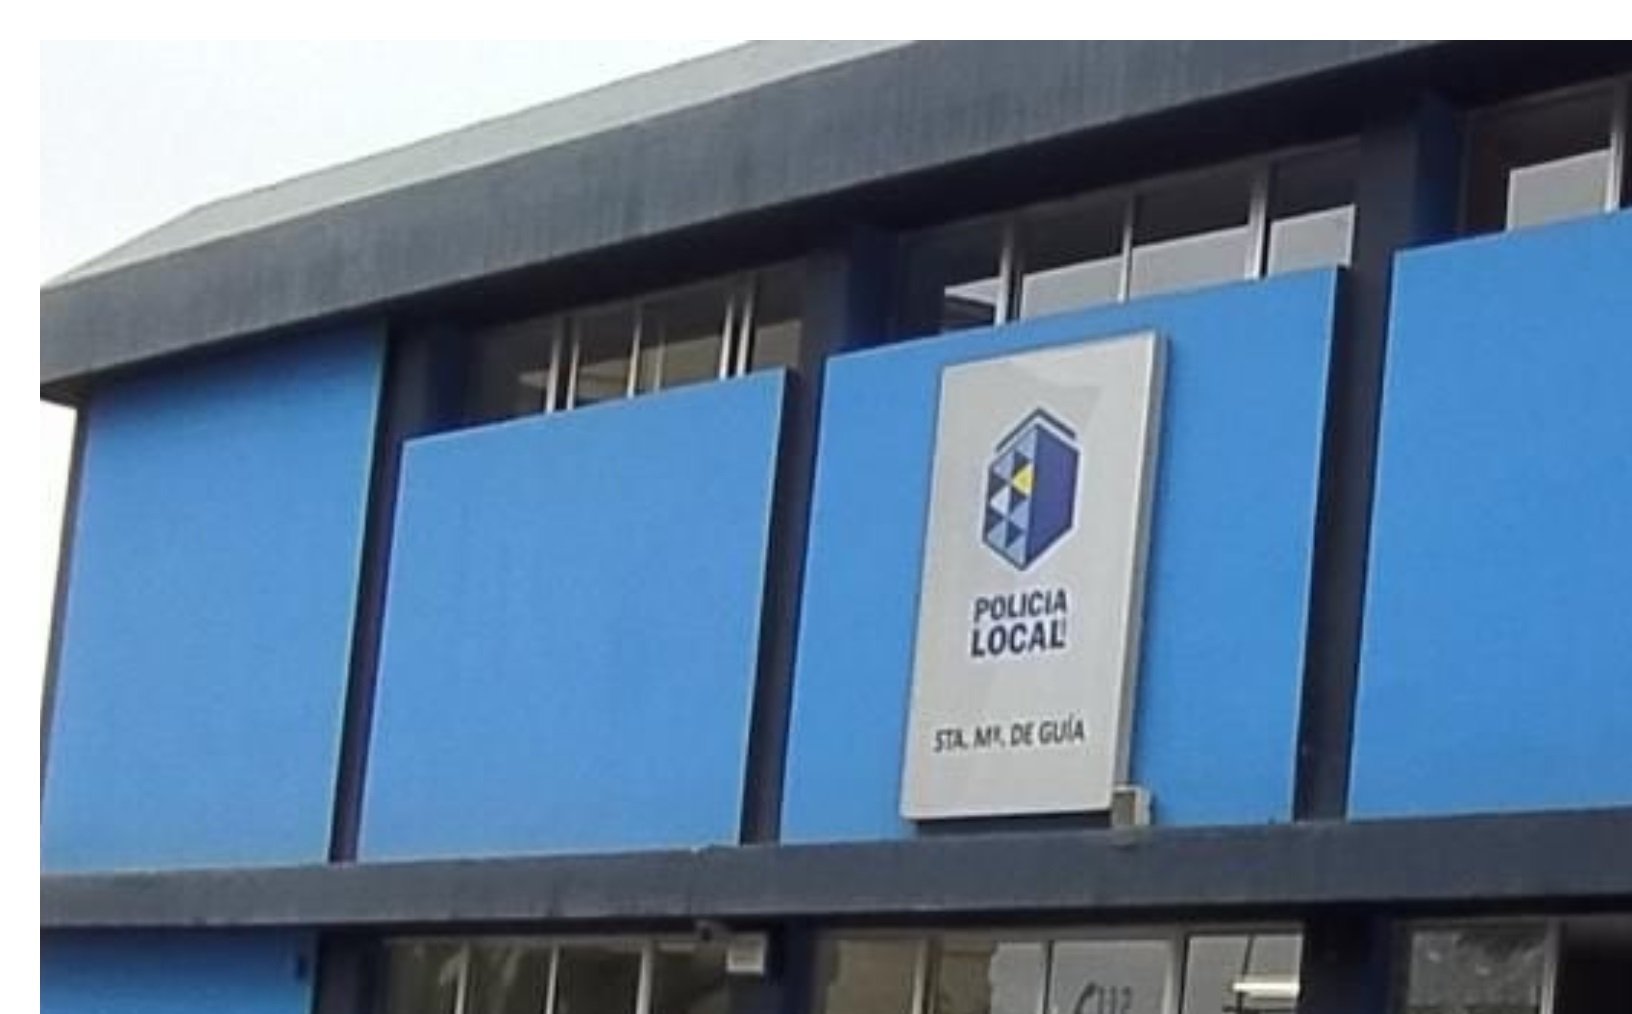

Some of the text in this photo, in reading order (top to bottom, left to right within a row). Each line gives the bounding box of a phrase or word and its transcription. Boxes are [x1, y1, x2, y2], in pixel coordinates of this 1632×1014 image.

[973, 588, 1067, 623] POLICIA
[971, 619, 1065, 658] LOCAL
[934, 728, 968, 752] STA.
[1010, 721, 1034, 746] DE
[1039, 712, 1084, 745] GUÍA
